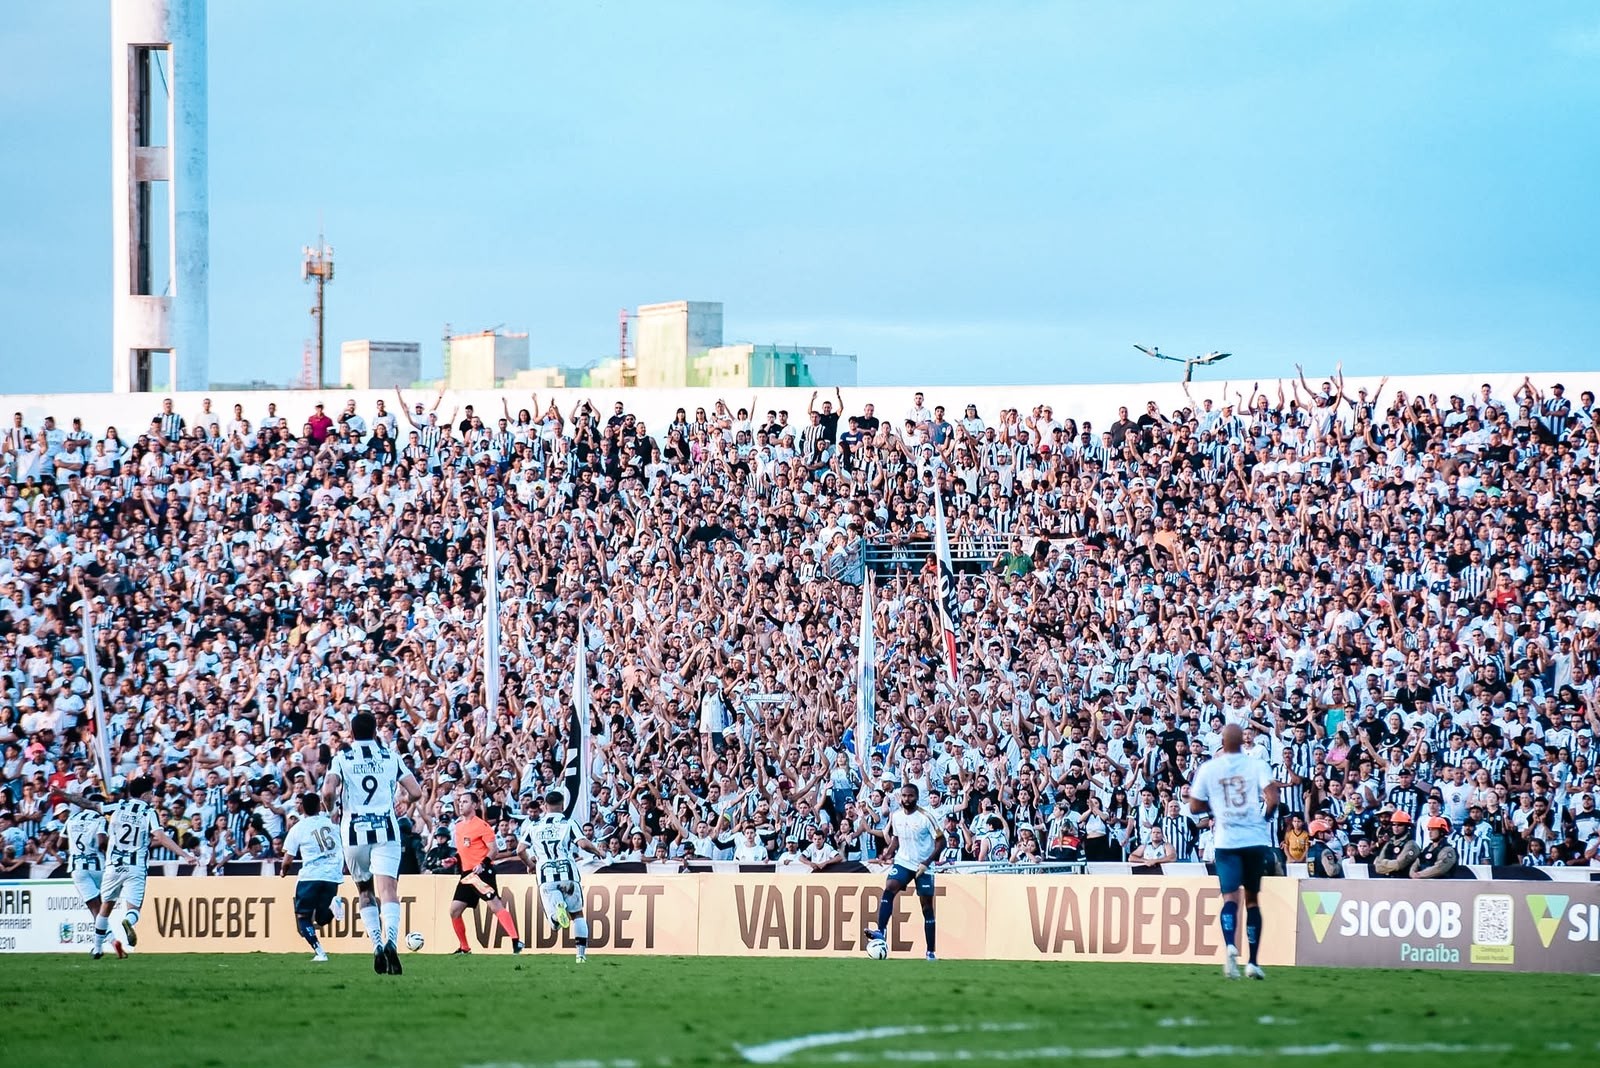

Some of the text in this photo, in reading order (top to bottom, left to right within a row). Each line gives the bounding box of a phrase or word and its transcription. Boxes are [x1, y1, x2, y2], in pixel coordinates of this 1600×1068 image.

[361, 775, 378, 806] 9
[1219, 776, 1247, 809] 13
[75, 833, 86, 852] 6
[119, 823, 140, 847] 21
[311, 826, 336, 853] 16
[540, 839, 562, 860] 17
[0, 890, 32, 914] RIA
[153, 897, 276, 938] VAIDEBET
[472, 885, 664, 949] VAIDBET
[1340, 900, 1462, 939] SICOOB
[1567, 904, 1599, 942] SI
[1400, 943, 1460, 963] Paraíba
